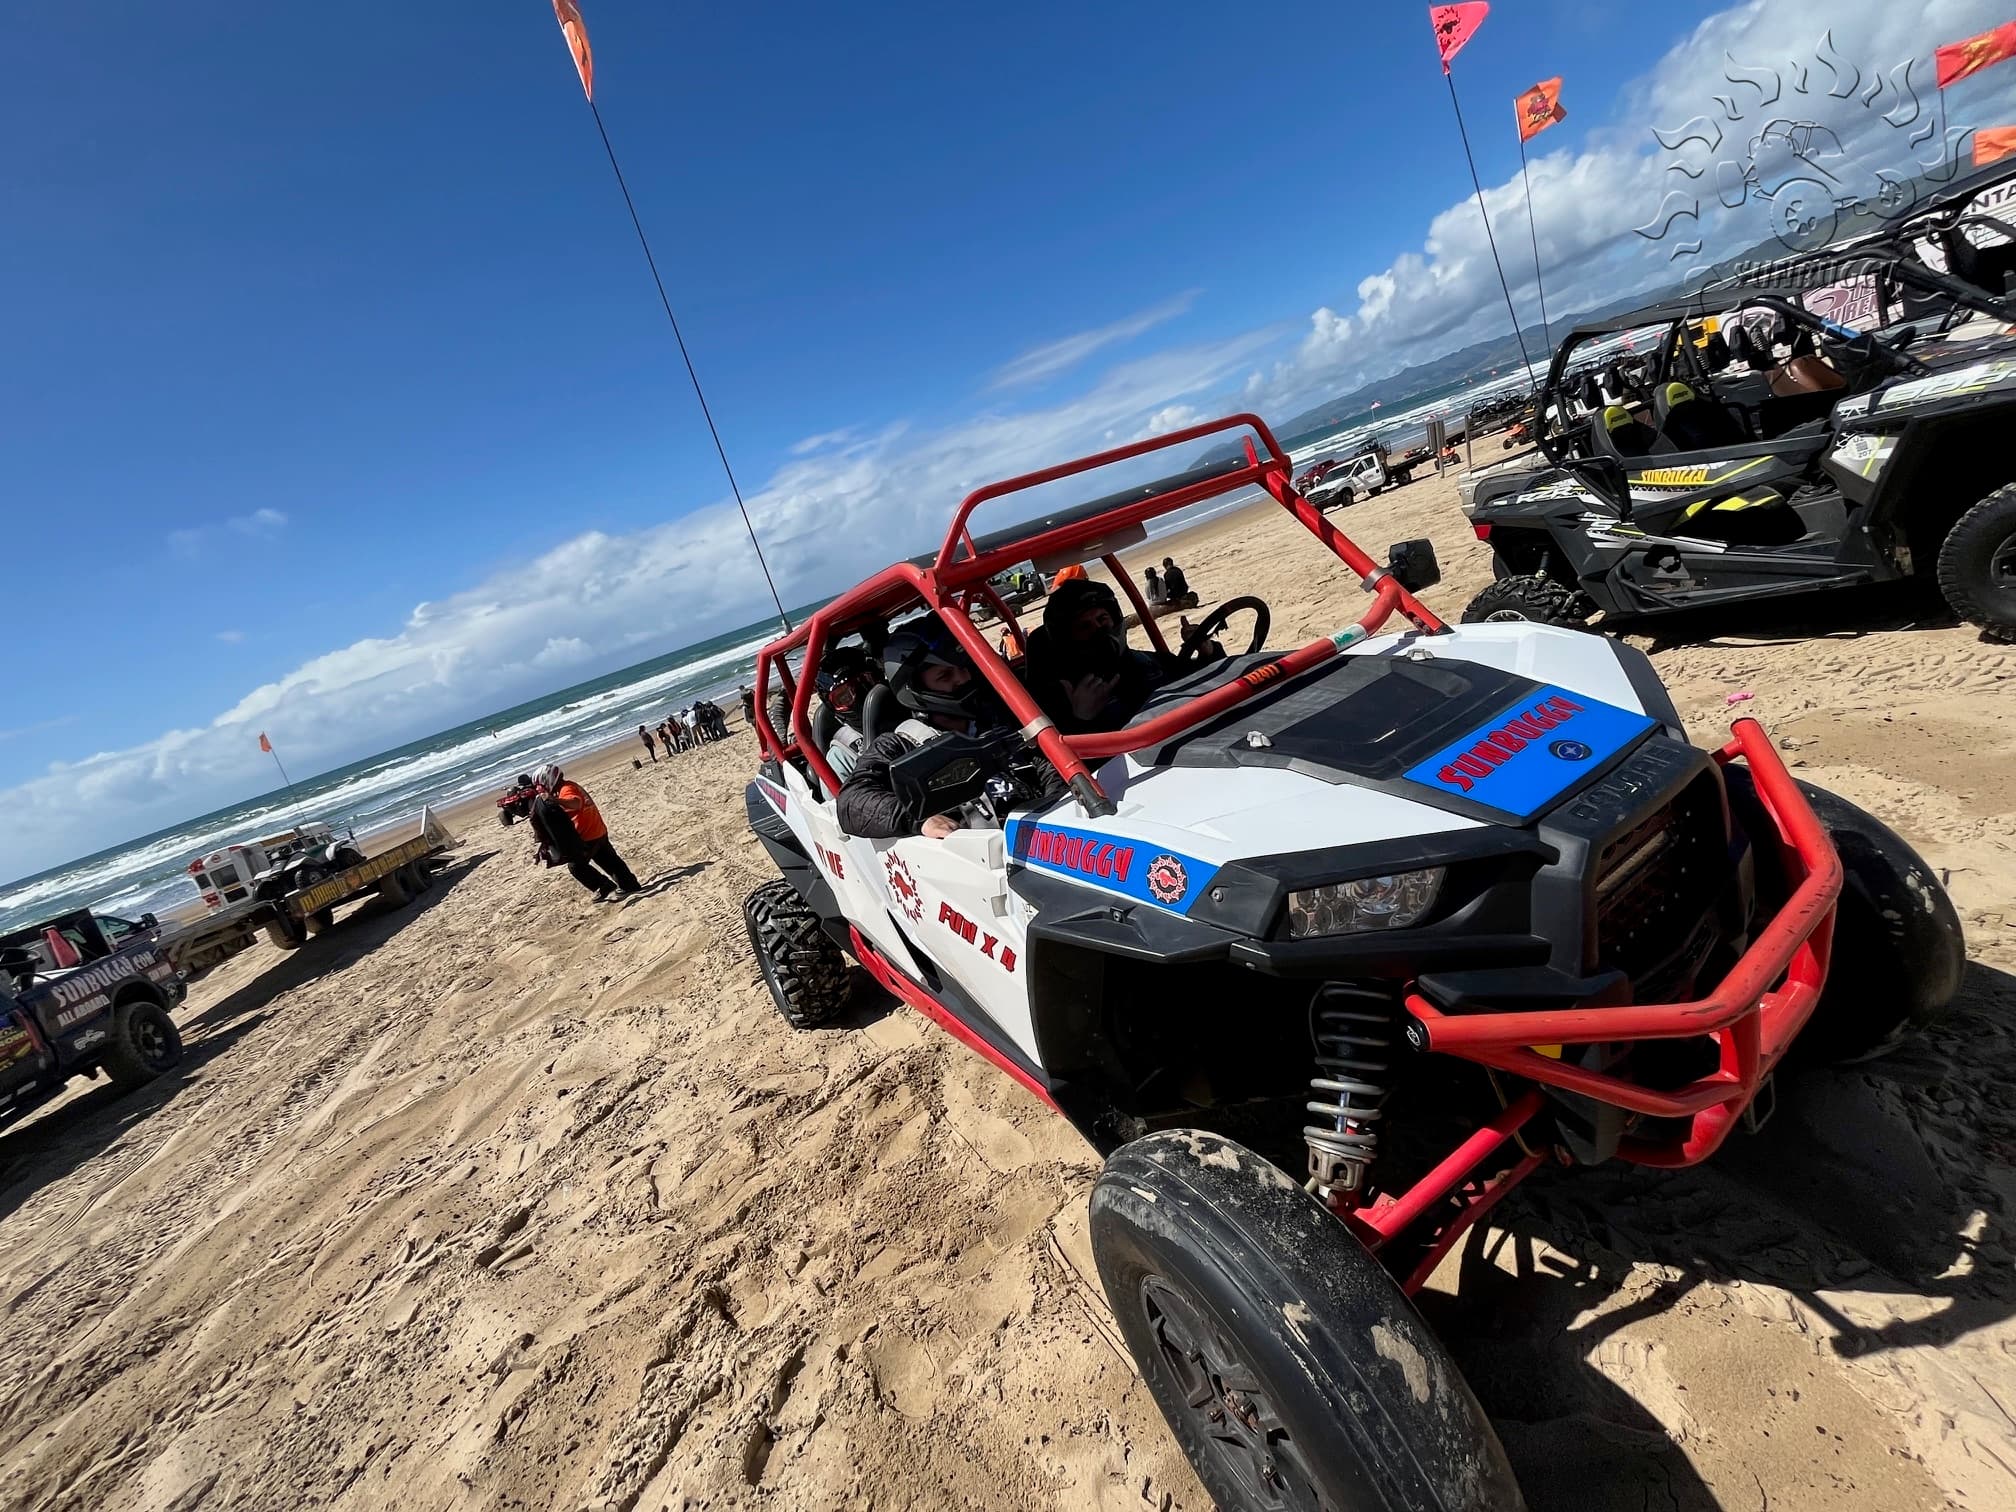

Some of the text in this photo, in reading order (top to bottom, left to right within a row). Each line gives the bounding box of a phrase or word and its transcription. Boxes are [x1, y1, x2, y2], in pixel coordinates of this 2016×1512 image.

[1641, 468, 1710, 483] SUNBUGGY
[1437, 696, 1585, 792] SUNBUGGY
[1019, 827, 1136, 882] SUNBUGGY
[939, 901, 978, 945] FUN
[980, 931, 999, 960] X
